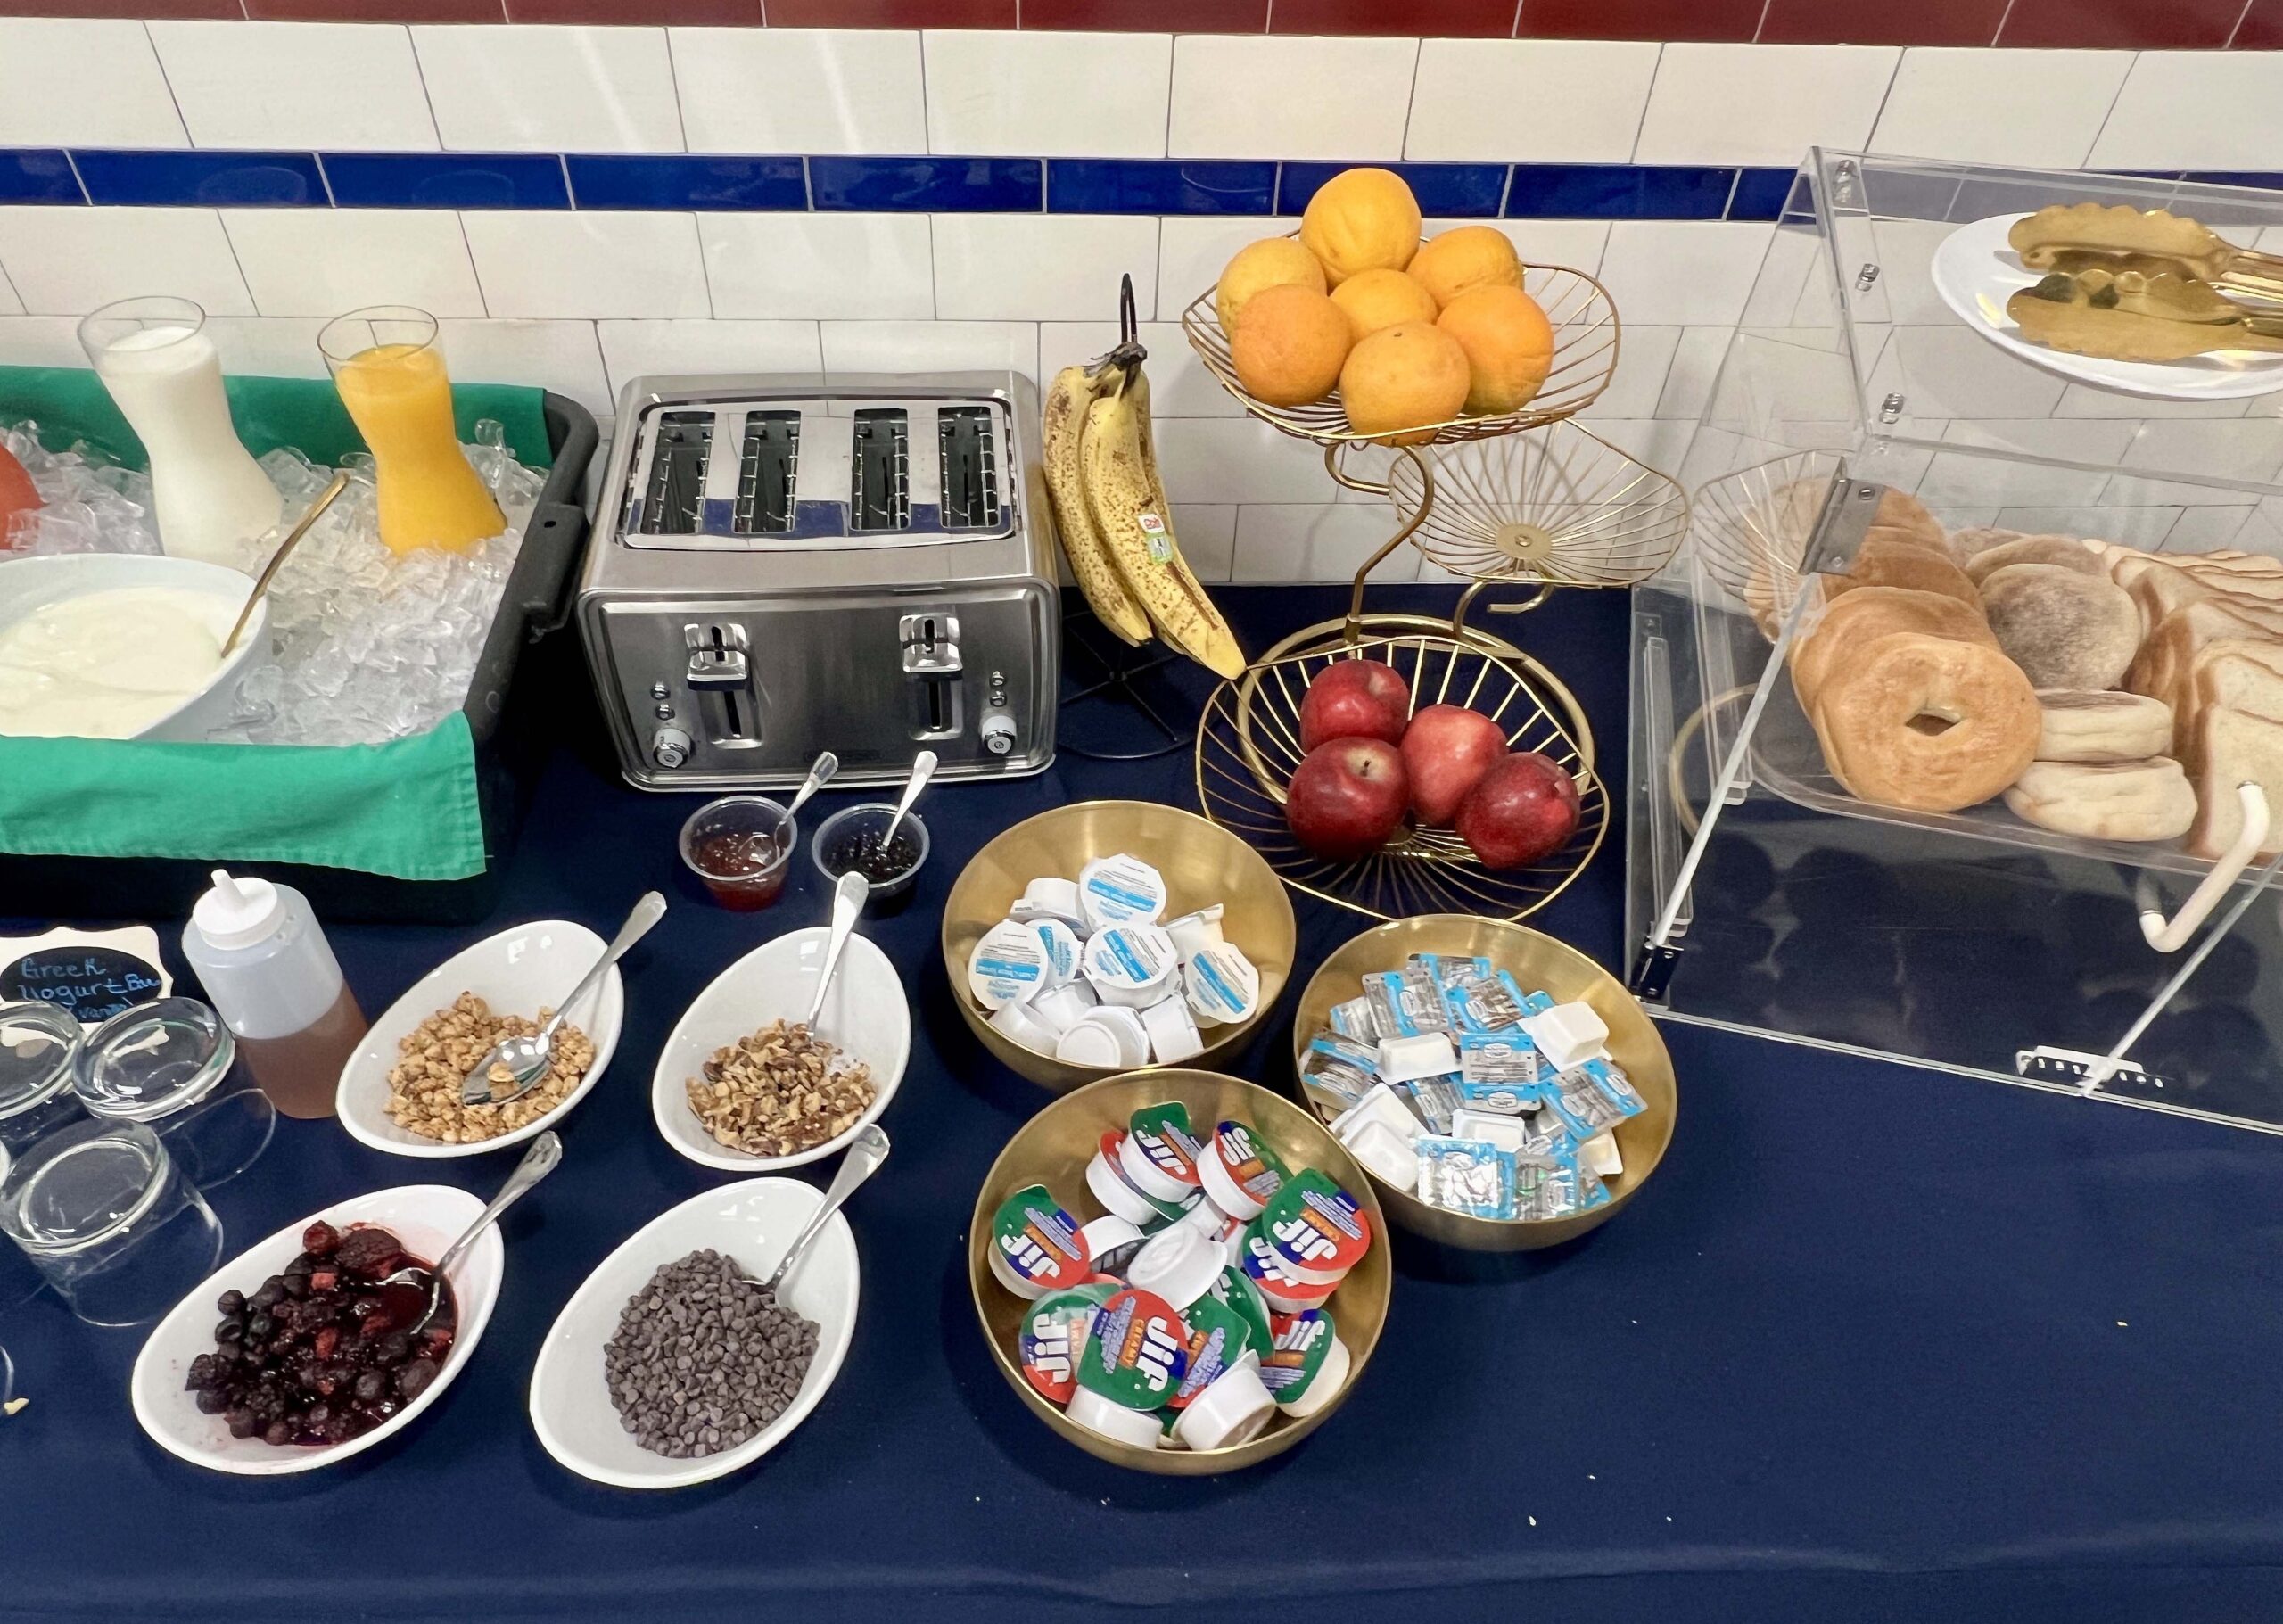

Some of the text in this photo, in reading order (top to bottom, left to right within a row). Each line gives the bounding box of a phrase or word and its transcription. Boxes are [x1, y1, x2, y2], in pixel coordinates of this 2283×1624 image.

[21, 957, 107, 979] Greek
[16, 978, 128, 1006] Yogurt
[1219, 1126, 1256, 1166] Jif
[1001, 1234, 1061, 1279] Jif
[1272, 1218, 1338, 1262] Jif
[1032, 1313, 1071, 1384] Jif
[1134, 1315, 1179, 1392] Jif
